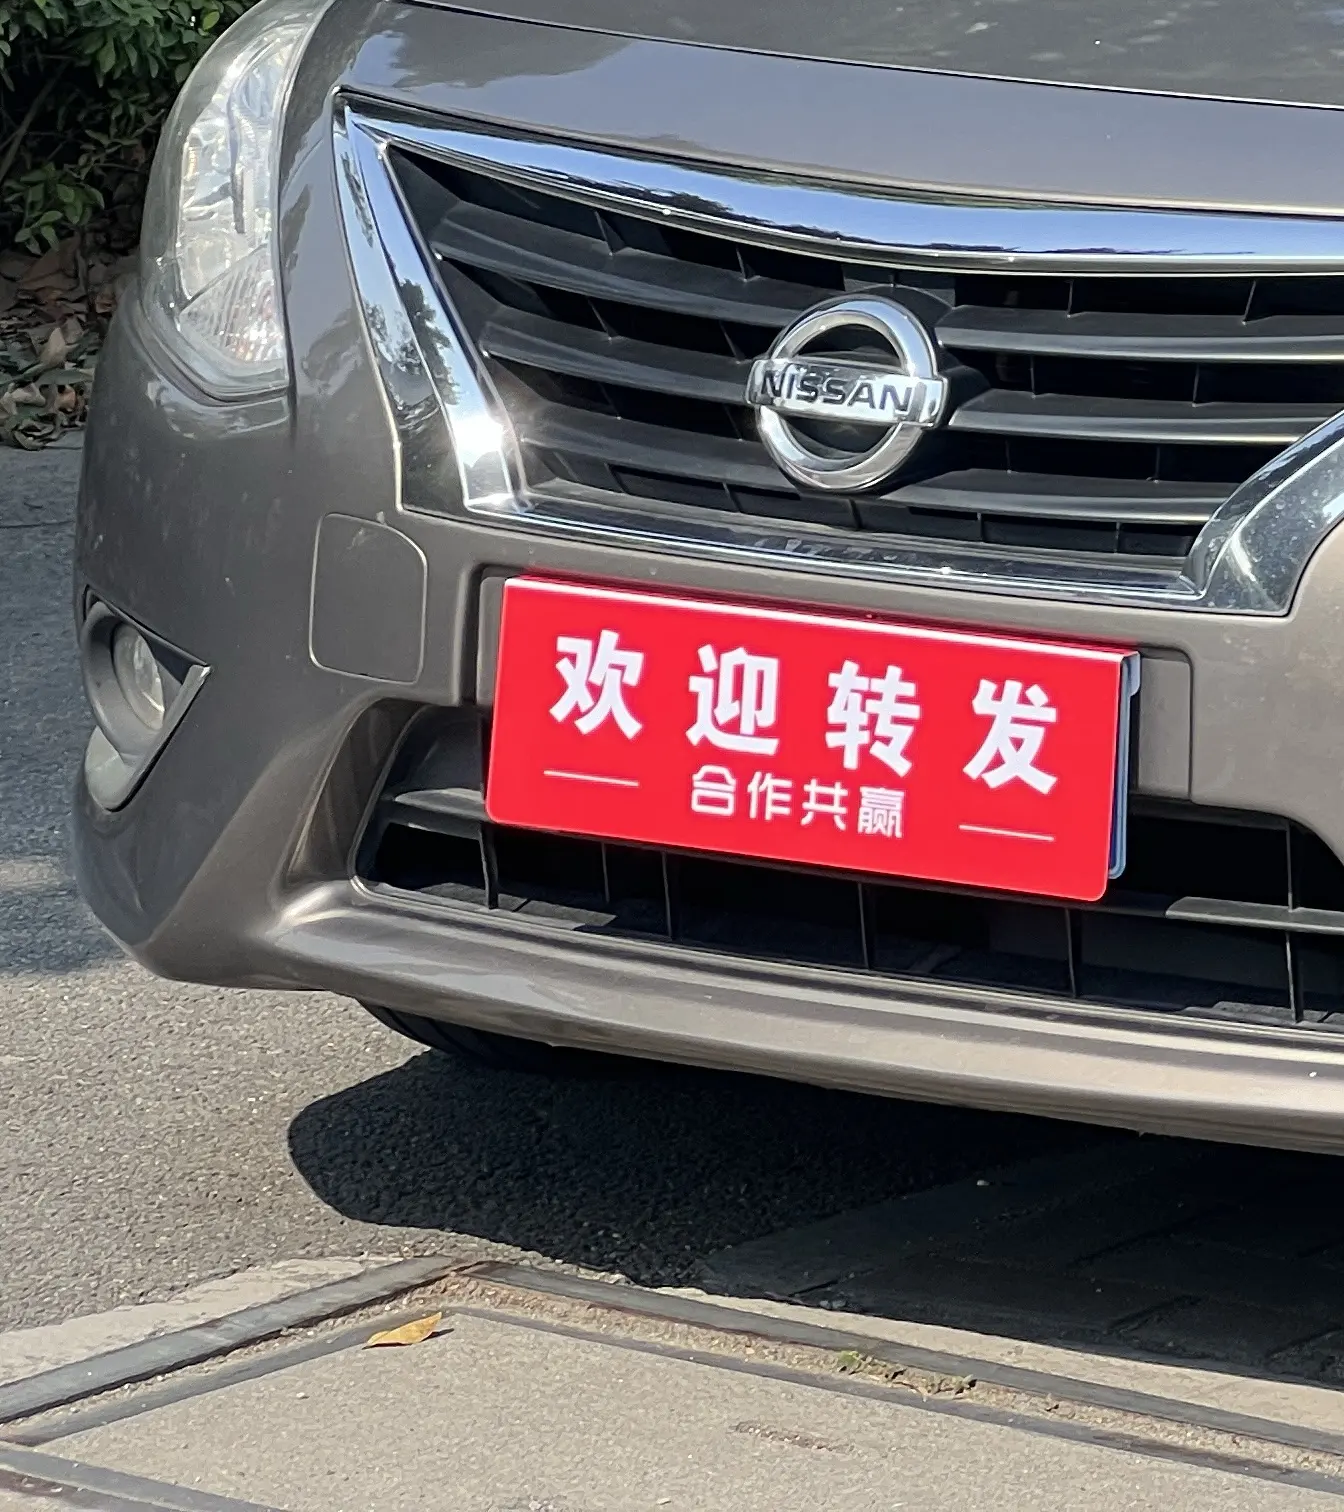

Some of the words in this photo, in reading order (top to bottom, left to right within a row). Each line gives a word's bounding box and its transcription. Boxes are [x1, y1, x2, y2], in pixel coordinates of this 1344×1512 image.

[760, 367, 913, 414] NISSAN
[548, 629, 1058, 795] 欢迎转发
[690, 763, 905, 838] 合作共赢
